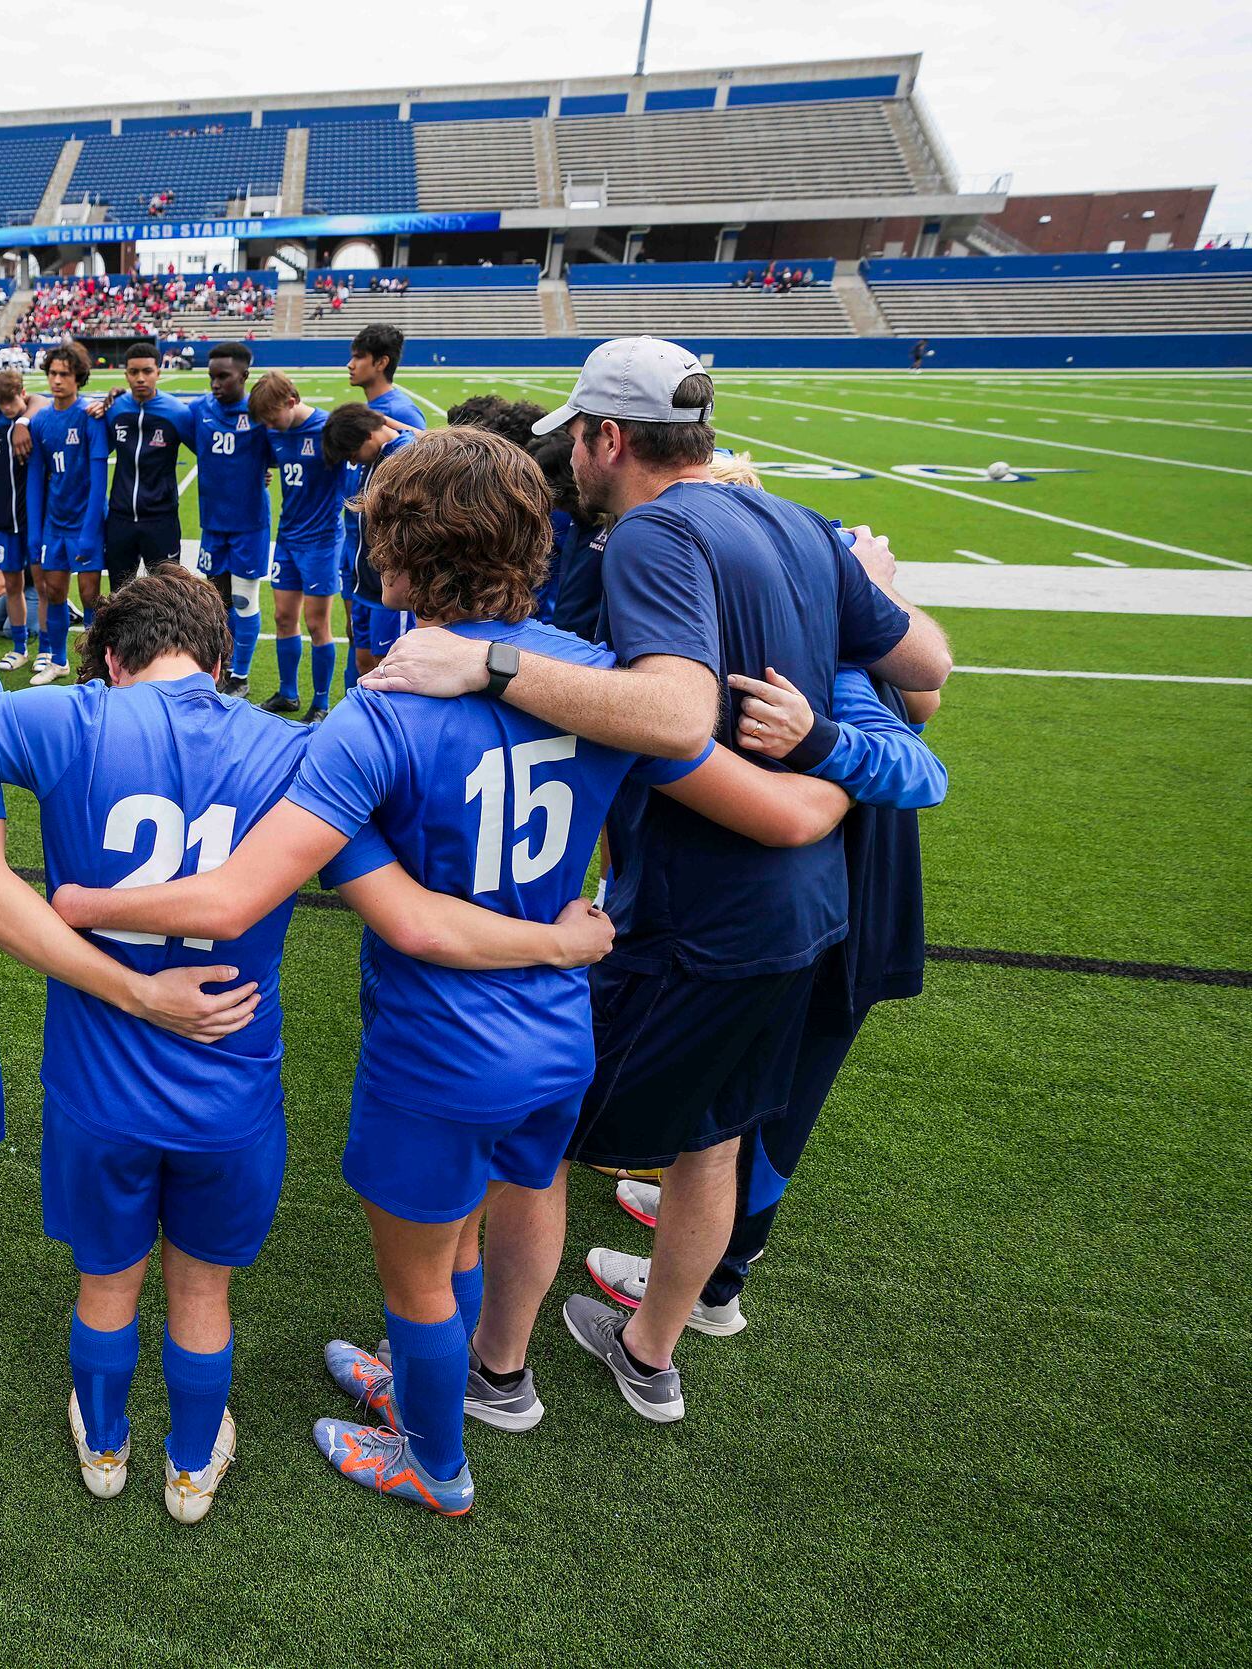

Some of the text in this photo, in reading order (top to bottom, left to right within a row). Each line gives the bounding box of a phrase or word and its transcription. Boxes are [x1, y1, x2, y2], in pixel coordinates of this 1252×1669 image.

[142, 224, 173, 239] ISD
[180, 220, 263, 238] STADIUM
[116, 429, 128, 443] 12
[212, 431, 235, 455] 20
[53, 451, 66, 473] 11
[284, 463, 303, 486] 22
[271, 562, 281, 583] 2
[465, 735, 577, 896] 15
[92, 793, 238, 953] 21
